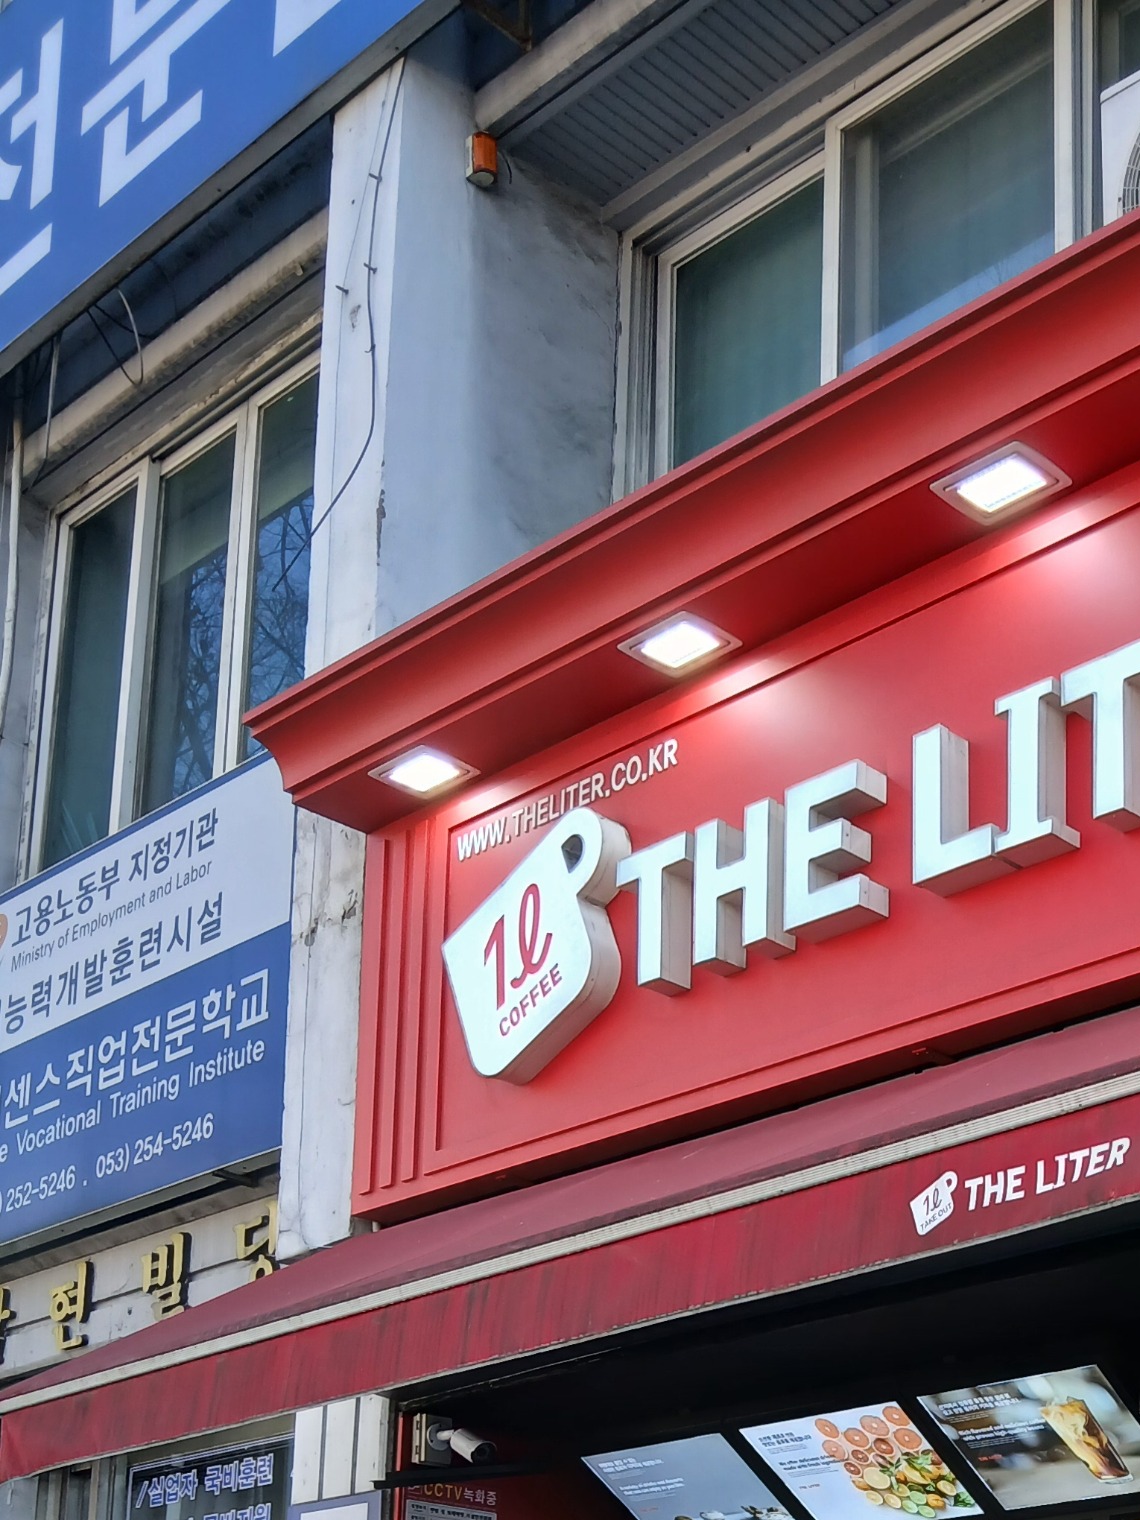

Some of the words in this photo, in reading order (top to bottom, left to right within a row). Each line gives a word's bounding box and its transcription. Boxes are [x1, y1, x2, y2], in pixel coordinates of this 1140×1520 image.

[457, 737, 679, 861] WWW.THELITER.CO.KR
[10, 857, 121, 949] 고용노동부
[129, 806, 219, 883] 지정기관
[10, 932, 55, 973] Ministry
[58, 926, 71, 949] of
[72, 893, 146, 944] Employment
[150, 879, 172, 904] and
[175, 860, 213, 895] Labor
[615, 757, 890, 997] THE
[4, 891, 226, 1036] 능력개발훈련시설
[498, 963, 563, 1039] COFFEE
[16, 1111, 101, 1157] Vocational
[111, 1071, 180, 1119] Training
[189, 1037, 266, 1088] Institute
[96, 1143, 130, 1179] 053)
[133, 1112, 215, 1164] 254-5246
[920, 1214, 938, 1232] TAKE
[937, 1202, 953, 1219] OUT
[964, 1165, 1027, 1212] THE
[1036, 1137, 1131, 1195] LITER
[204, 1453, 275, 1496] 국비훈련
